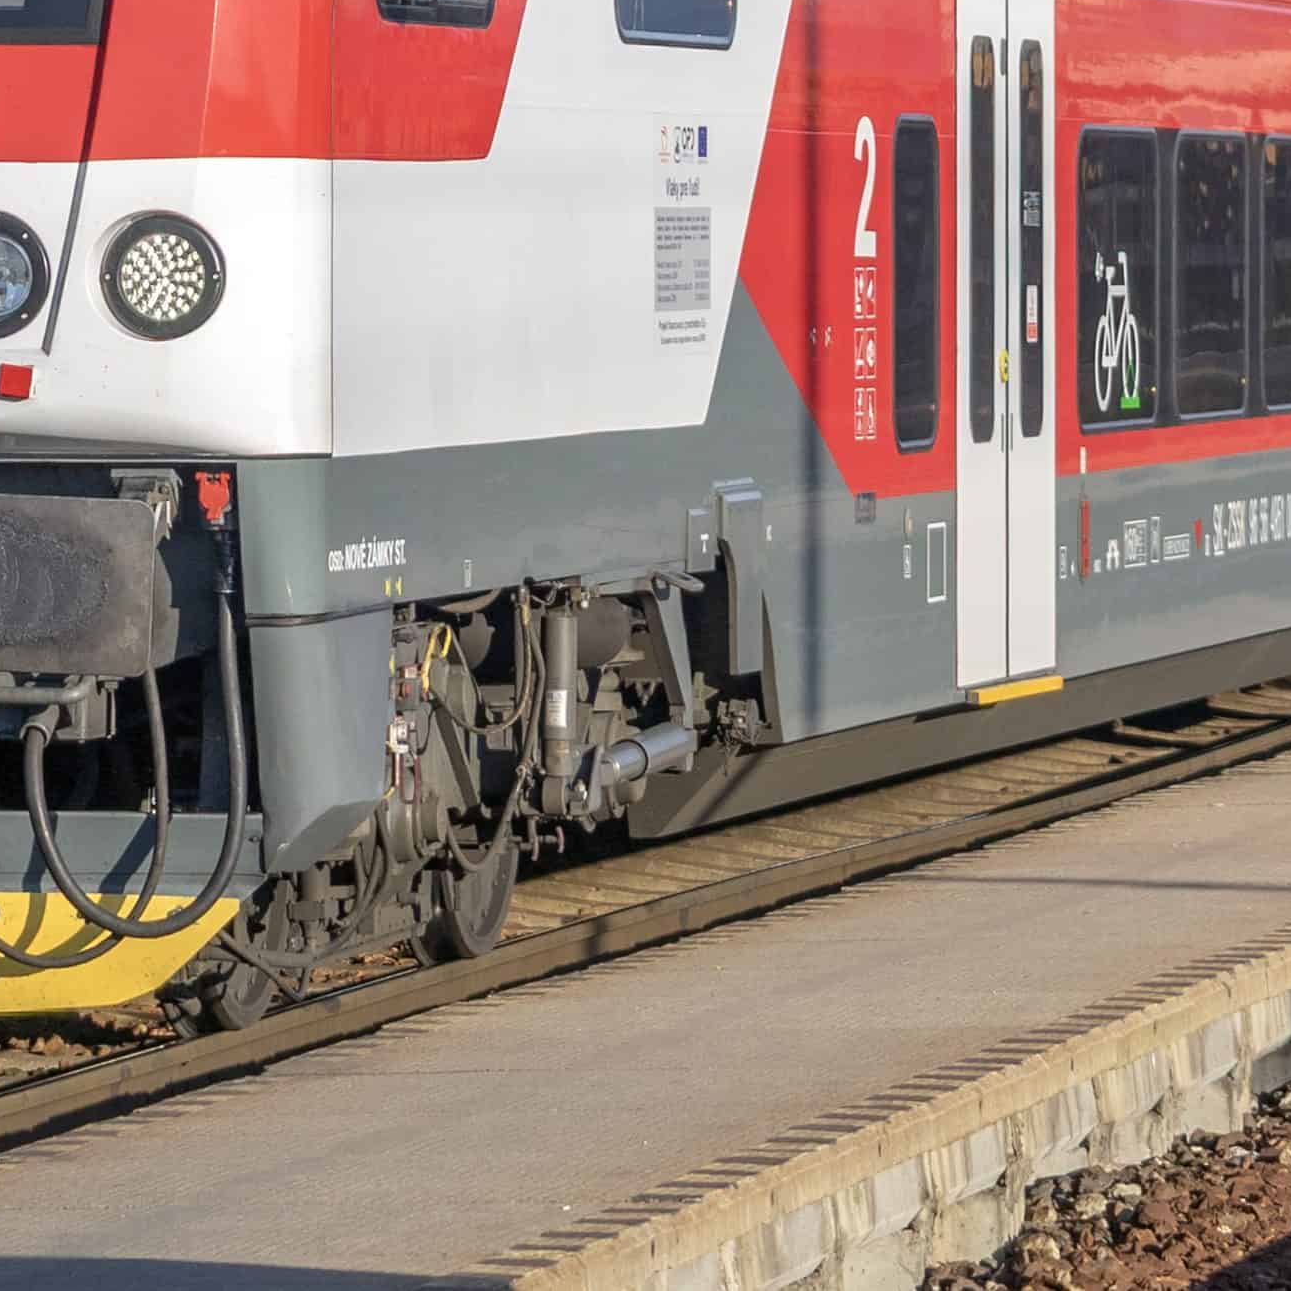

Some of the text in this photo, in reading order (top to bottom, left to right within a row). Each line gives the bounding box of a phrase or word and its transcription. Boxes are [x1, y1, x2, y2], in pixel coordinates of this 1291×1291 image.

[854, 116, 877, 257] 2
[344, 535, 367, 571] NOVÉ
[367, 534, 395, 569] ZÁMKY
